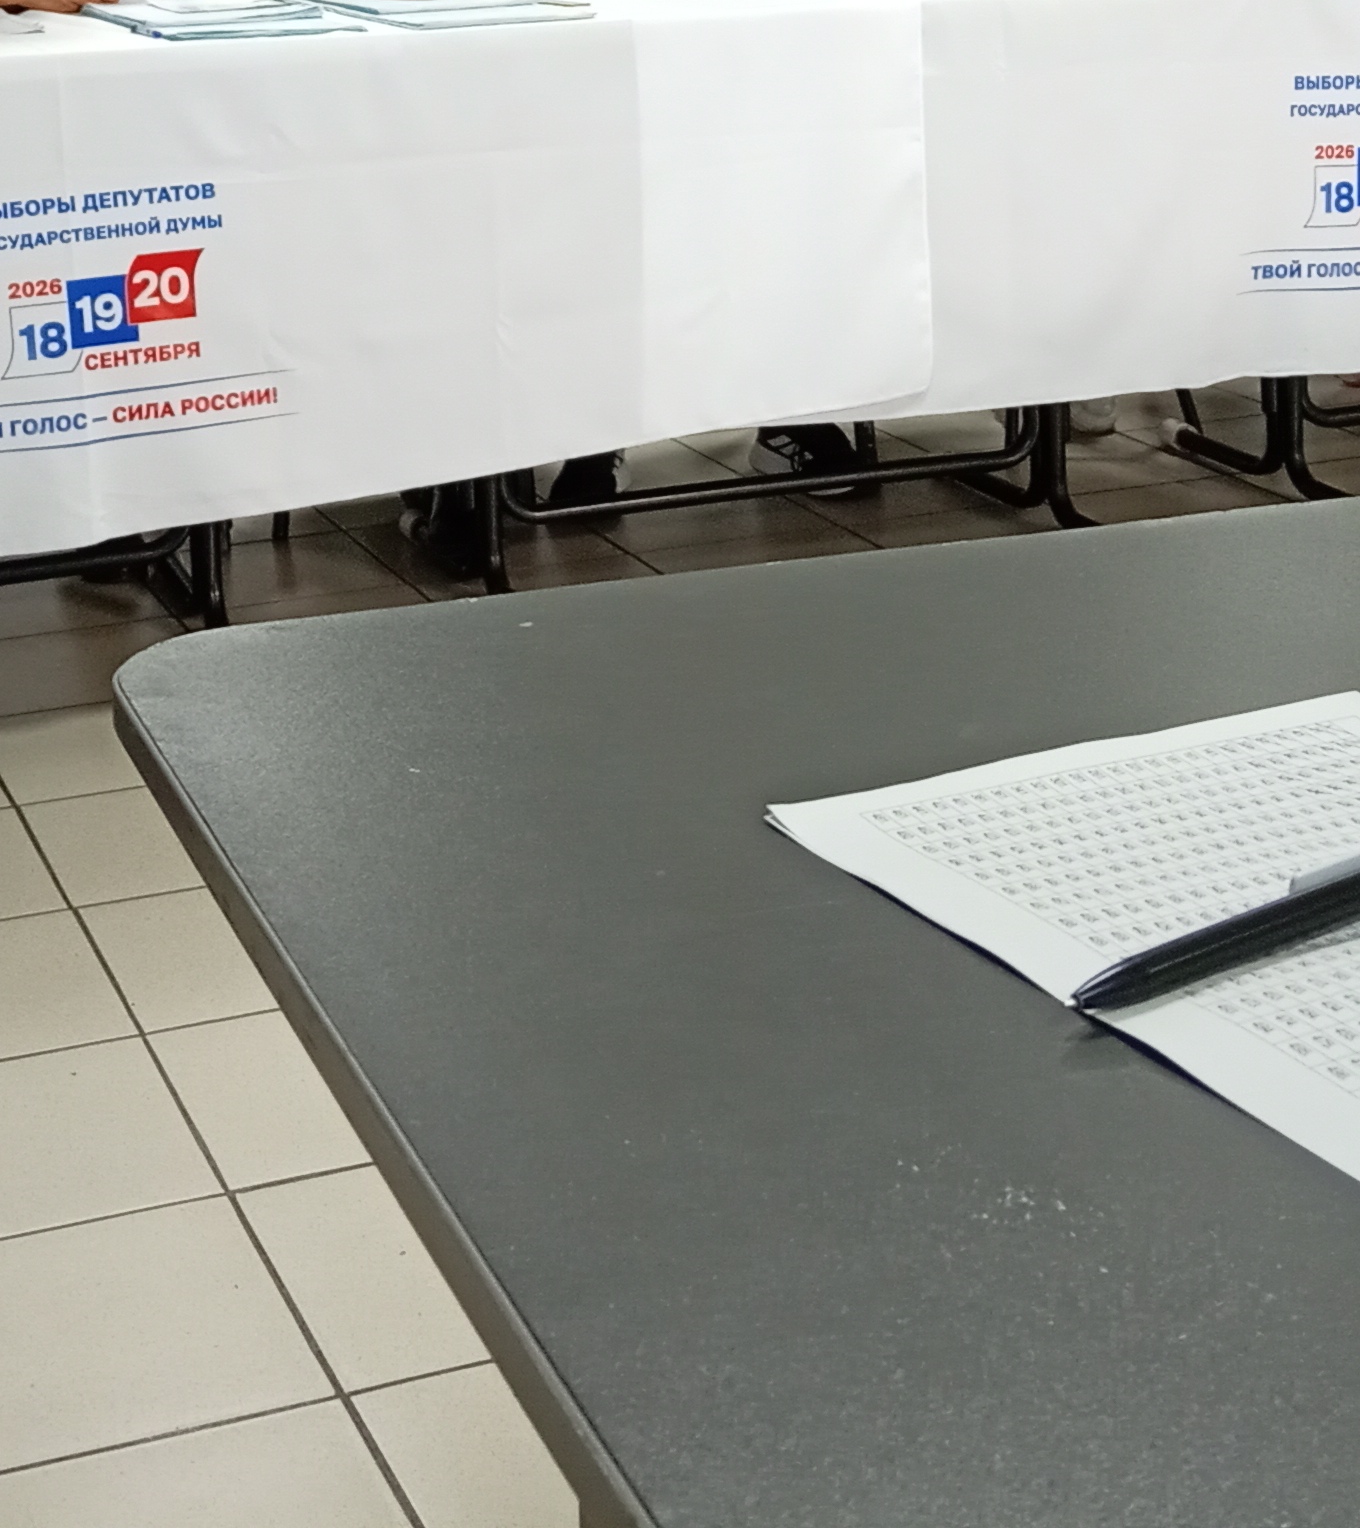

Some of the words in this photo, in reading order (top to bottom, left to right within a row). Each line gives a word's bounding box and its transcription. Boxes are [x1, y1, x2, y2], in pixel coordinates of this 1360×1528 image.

[1314, 145, 1355, 159] 2026
[82, 183, 216, 213] ДЕПУТАТОВ
[1320, 181, 1354, 214] 18
[166, 215, 223, 235] ДУМЫ
[1251, 260, 1302, 280] ТВОЙ
[8, 279, 62, 300] 2026
[18, 322, 67, 361] 18
[75, 292, 123, 333] 19
[132, 267, 189, 308] 20
[84, 342, 201, 371] СЕНТЯБРЯ
[10, 413, 87, 438] ГОЛОС
[113, 401, 176, 424] СИЛА
[181, 388, 278, 415] РОССИИ!
